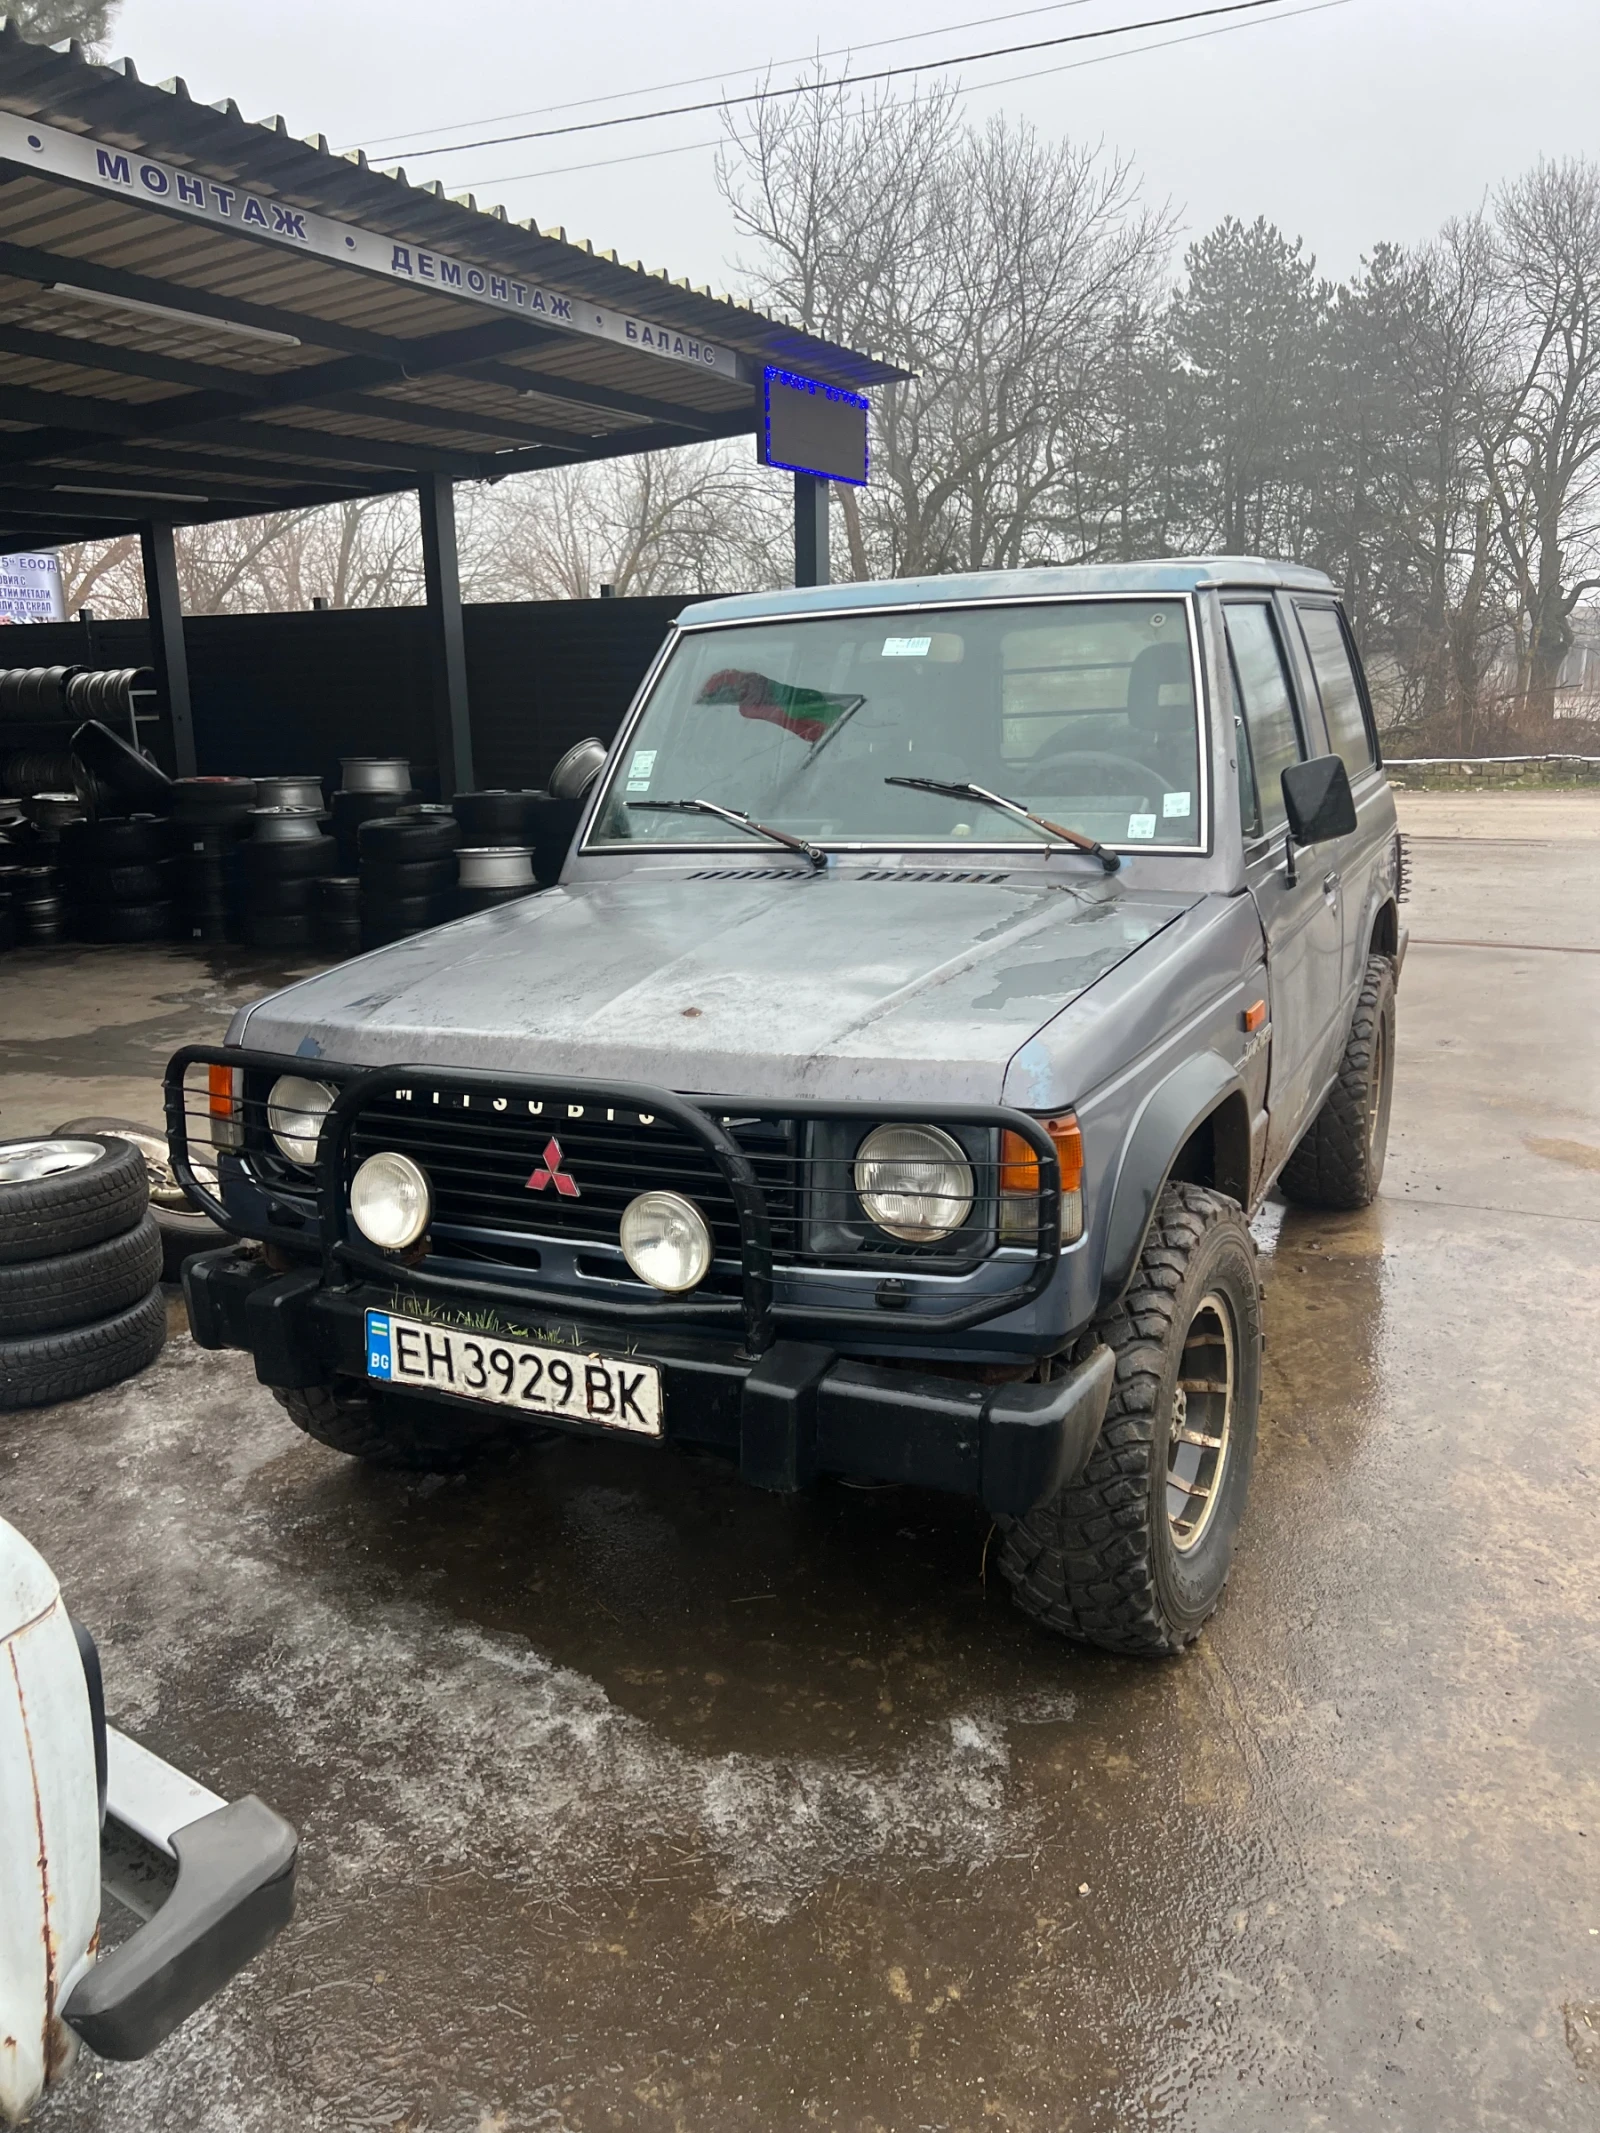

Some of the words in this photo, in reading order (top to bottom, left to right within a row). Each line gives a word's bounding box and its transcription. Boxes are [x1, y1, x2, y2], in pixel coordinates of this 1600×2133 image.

[95, 148, 308, 241] МОНТАЖ
[391, 245, 573, 322] ДЕМОНТАЖ
[625, 321, 716, 366] БАЛАНС
[19, 558, 57, 572] ЕООД
[20, 589, 51, 599] МЕТАЛИ
[14, 600, 25, 610] ЗА
[26, 601, 52, 612] СКРАП
[370, 1352, 389, 1370] BG
